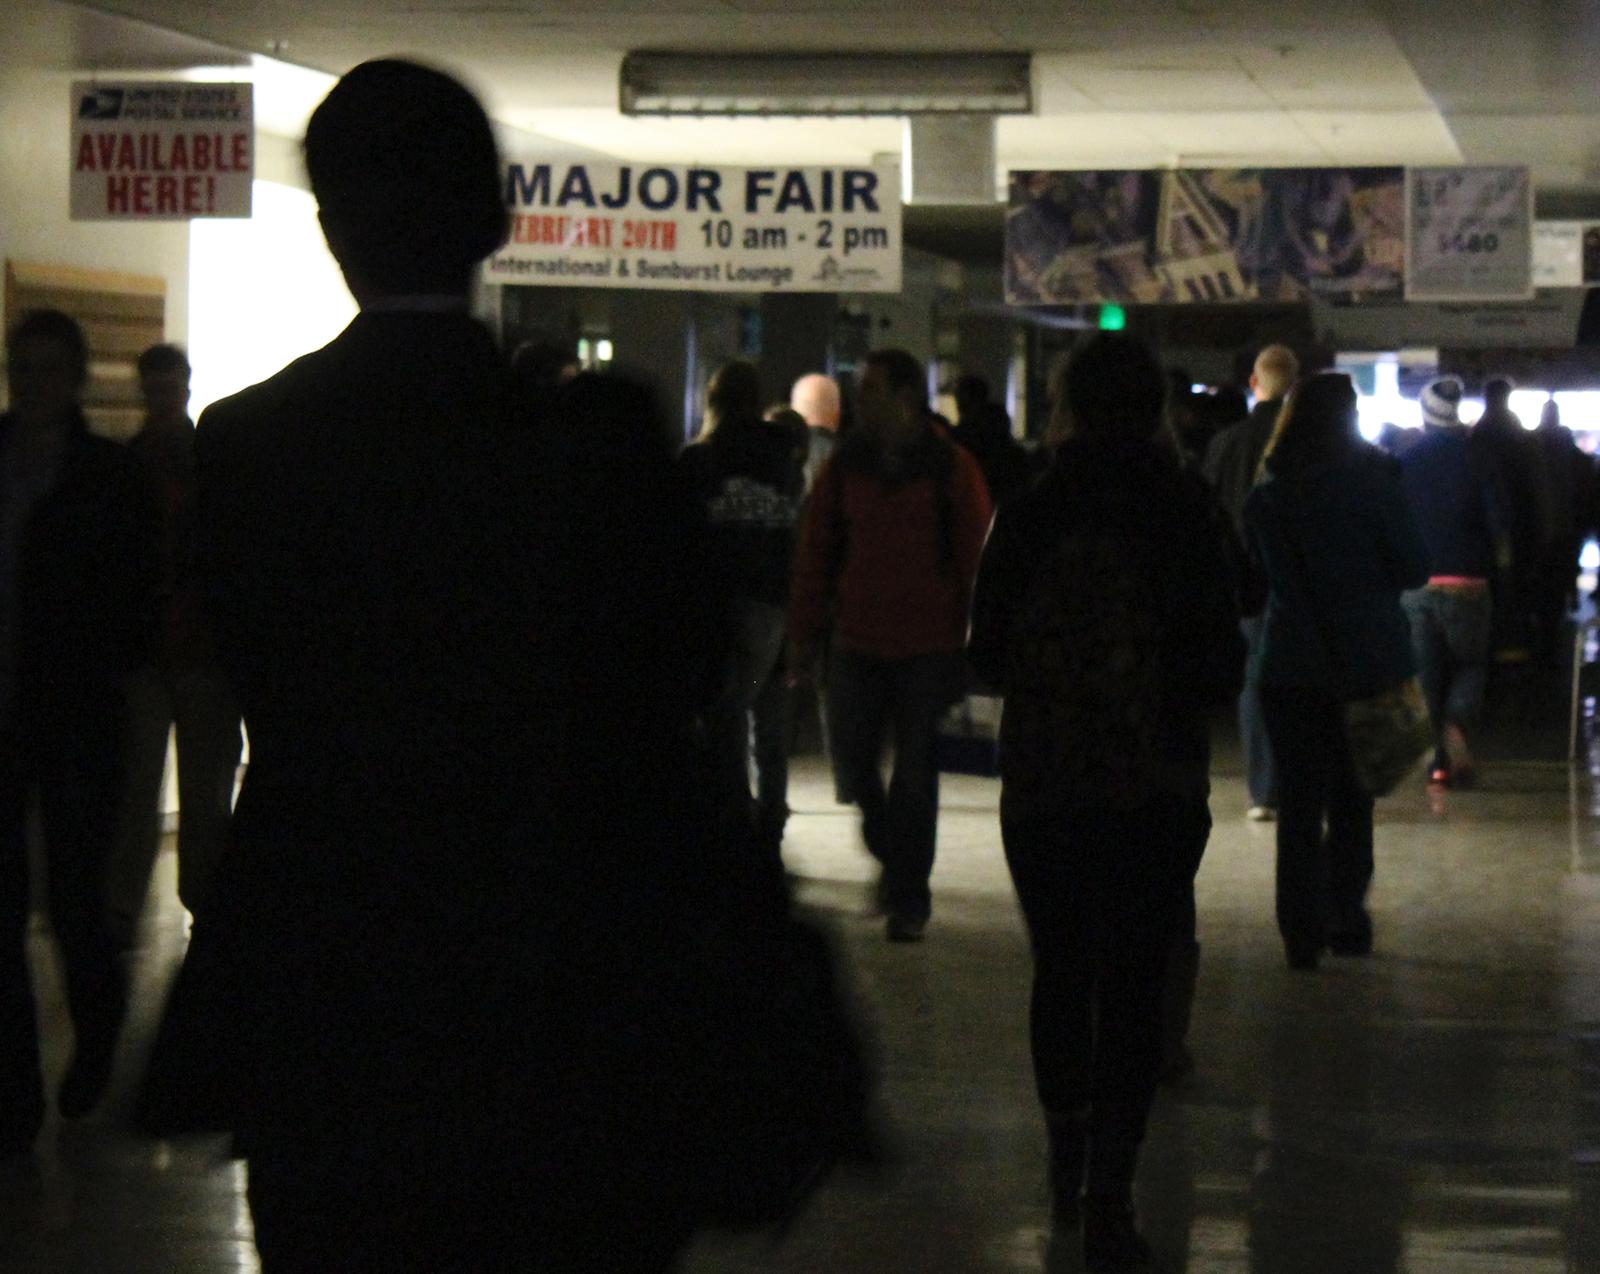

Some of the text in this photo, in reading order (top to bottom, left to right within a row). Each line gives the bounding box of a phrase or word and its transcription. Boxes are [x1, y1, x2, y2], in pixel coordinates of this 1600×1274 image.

[76, 133, 248, 171] AVAILABLE
[107, 176, 216, 214] HERE!
[507, 164, 880, 214] MAJOR FAIR
[513, 214, 612, 247] EBRARY
[623, 220, 677, 251] 20TH
[701, 219, 732, 248] 10
[743, 227, 787, 249] am
[817, 220, 833, 248] 2
[844, 227, 888, 256] pm
[491, 256, 793, 286] International & Sunburst Lounge
